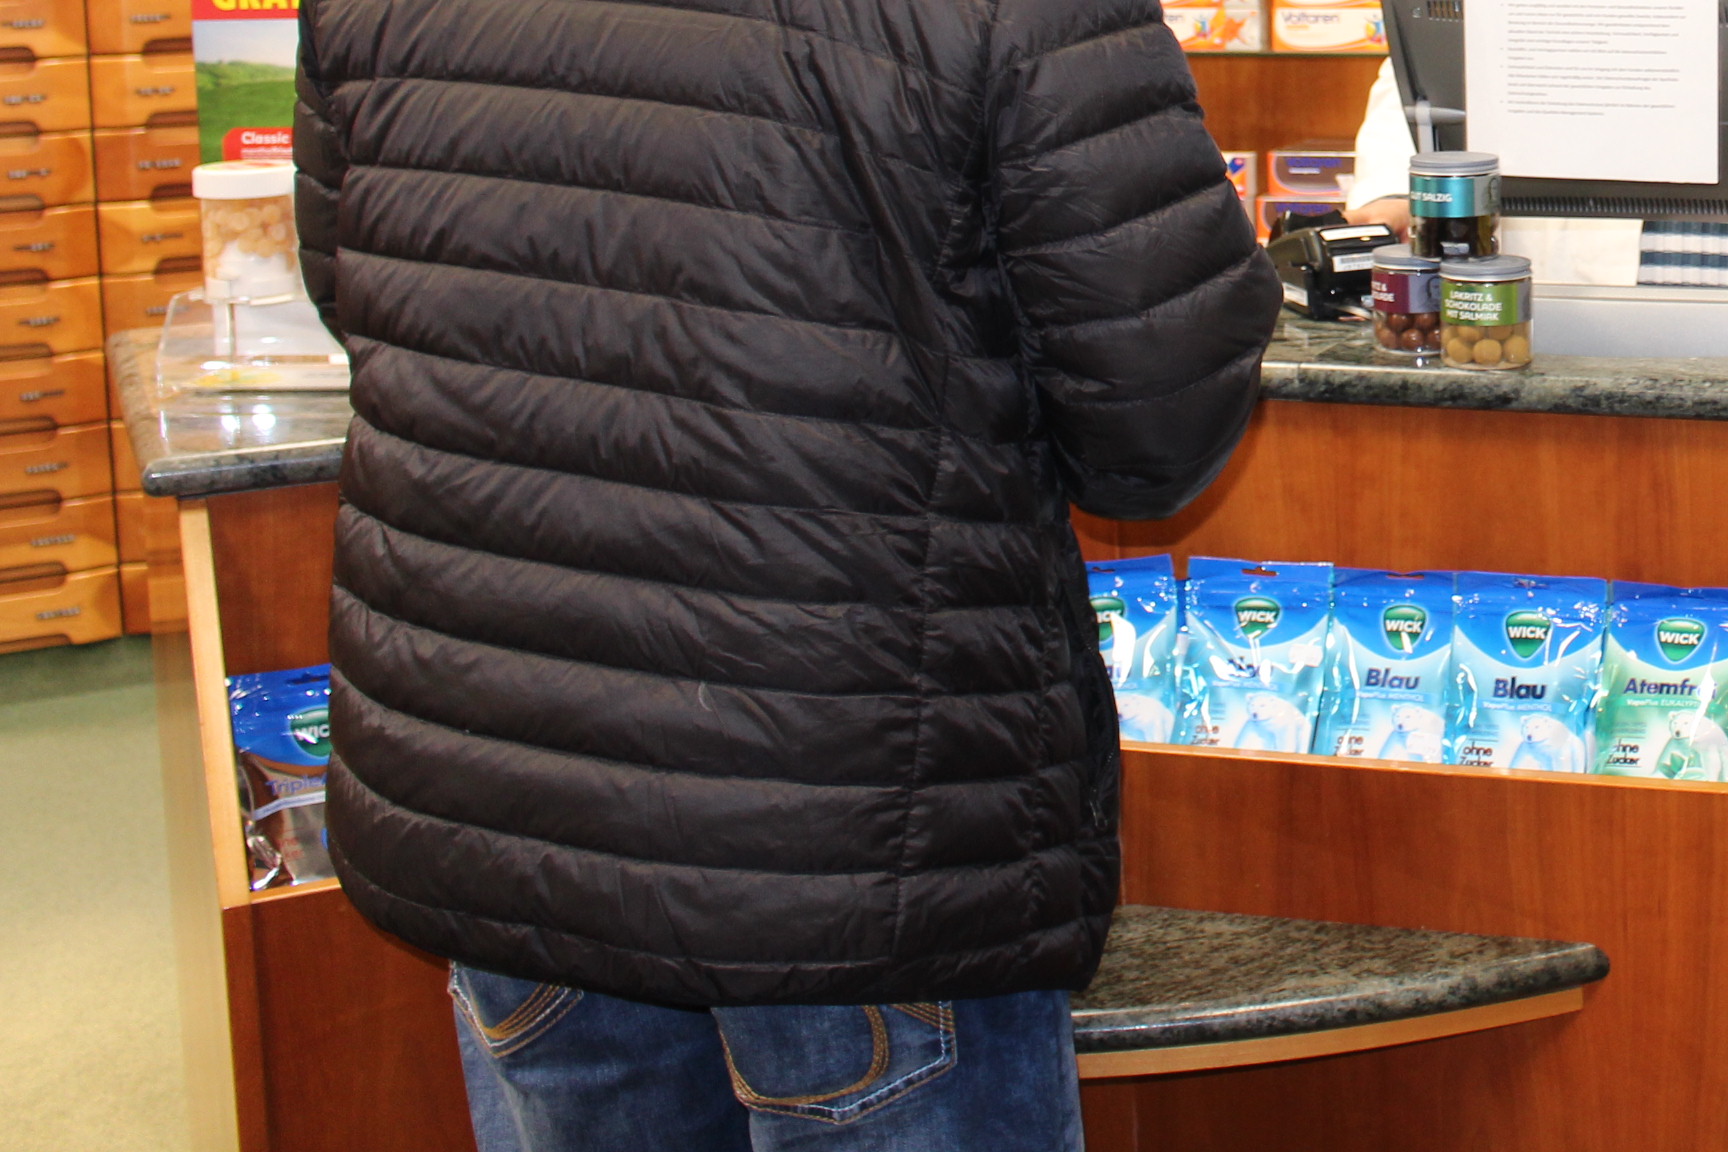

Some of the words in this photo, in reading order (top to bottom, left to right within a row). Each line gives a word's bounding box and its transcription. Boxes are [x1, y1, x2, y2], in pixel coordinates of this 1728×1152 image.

[1281, 11, 1339, 24] Voltaren
[241, 131, 290, 145] Classic
[1423, 193, 1453, 203] SALZIG
[1450, 291, 1480, 301] LAKRITZ
[1444, 301, 1502, 312] SCHOKOLADE
[1459, 311, 1499, 321] SALMIAK
[1237, 610, 1276, 623] WICK
[1385, 620, 1422, 634] WICK
[1508, 625, 1547, 641] WICK
[1658, 631, 1699, 646] WICK
[1366, 668, 1420, 689] Blau
[1493, 678, 1547, 699] Blau
[1660, 699, 1701, 708] EUKALYPT
[294, 724, 330, 741] WIC
[1463, 742, 1493, 757] ohne
